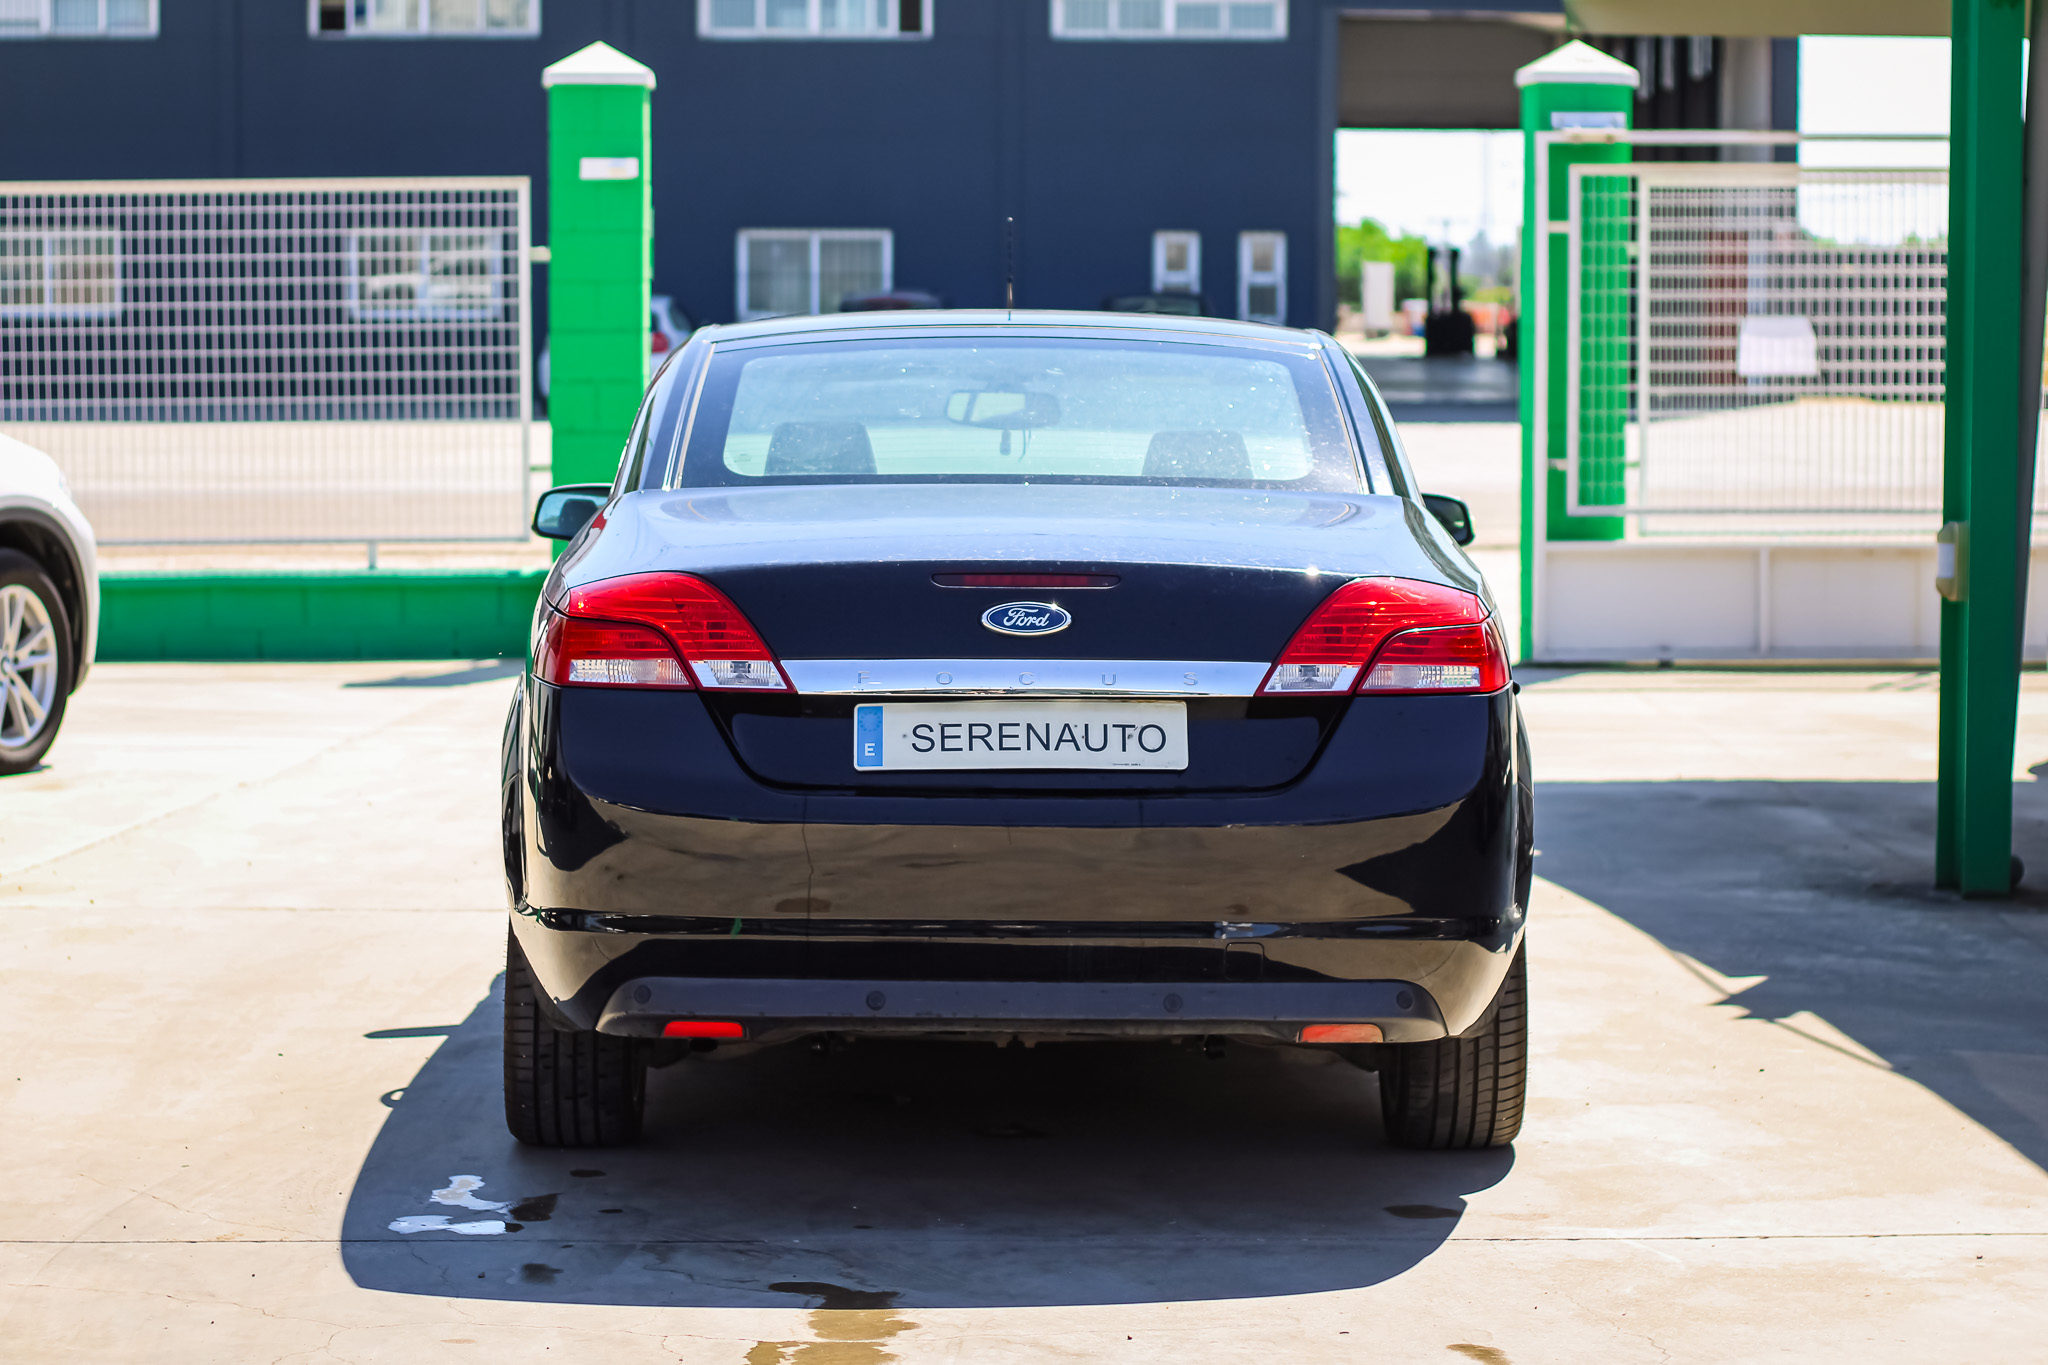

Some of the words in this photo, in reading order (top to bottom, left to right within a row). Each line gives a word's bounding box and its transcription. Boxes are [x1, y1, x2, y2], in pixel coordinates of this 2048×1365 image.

[1003, 607, 1050, 627] Ford
[857, 671, 1199, 685] FOCUS
[911, 723, 1167, 753] SERENAUTO
[865, 743, 876, 757] E
